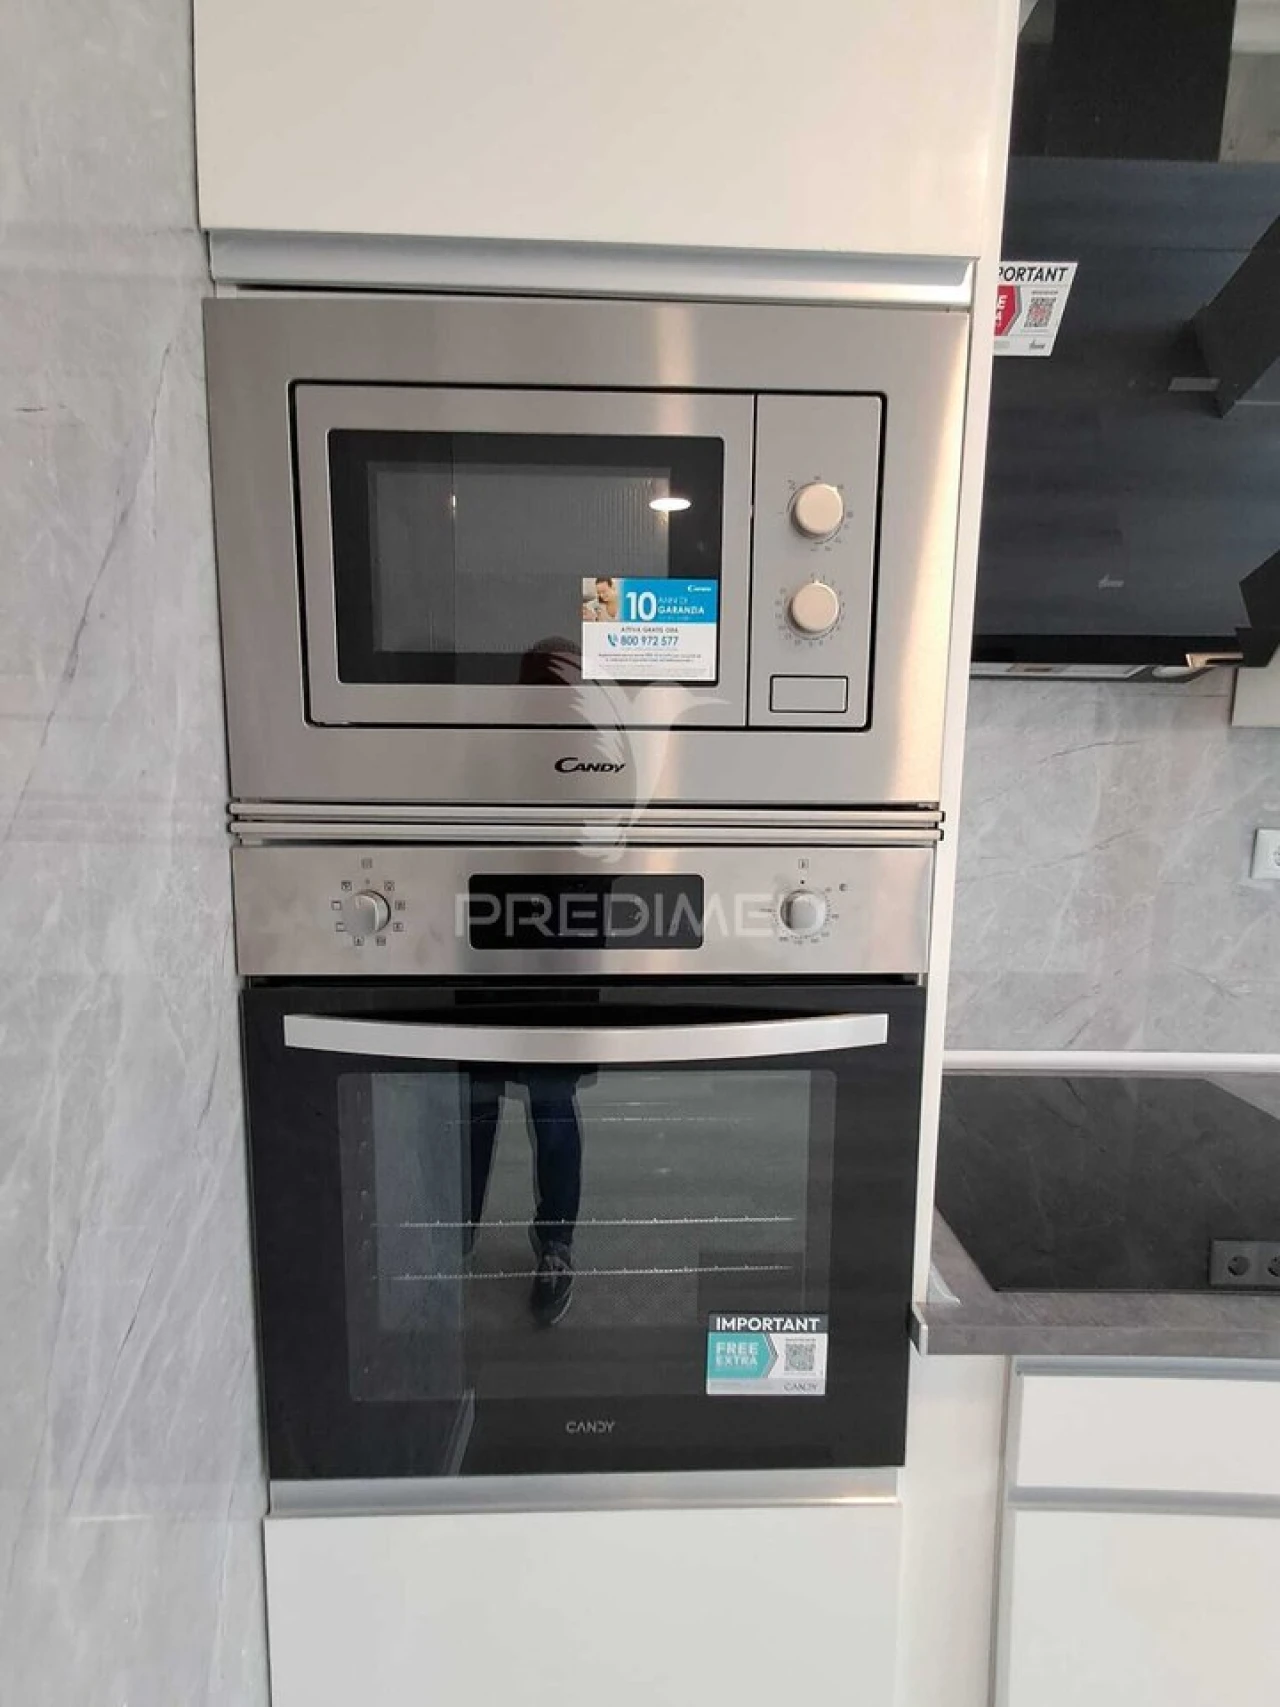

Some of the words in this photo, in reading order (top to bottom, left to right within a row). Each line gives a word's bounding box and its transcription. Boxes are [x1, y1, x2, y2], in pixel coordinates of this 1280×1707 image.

[625, 591, 657, 621] 10
[620, 635, 639, 646] 800
[641, 635, 659, 646] 972
[660, 636, 679, 646] 577
[715, 1317, 821, 1331] IMPORTANT
[716, 1342, 759, 1356] FREE
[715, 1355, 759, 1367] EXTRA
[566, 1421, 616, 1434] CANDY
